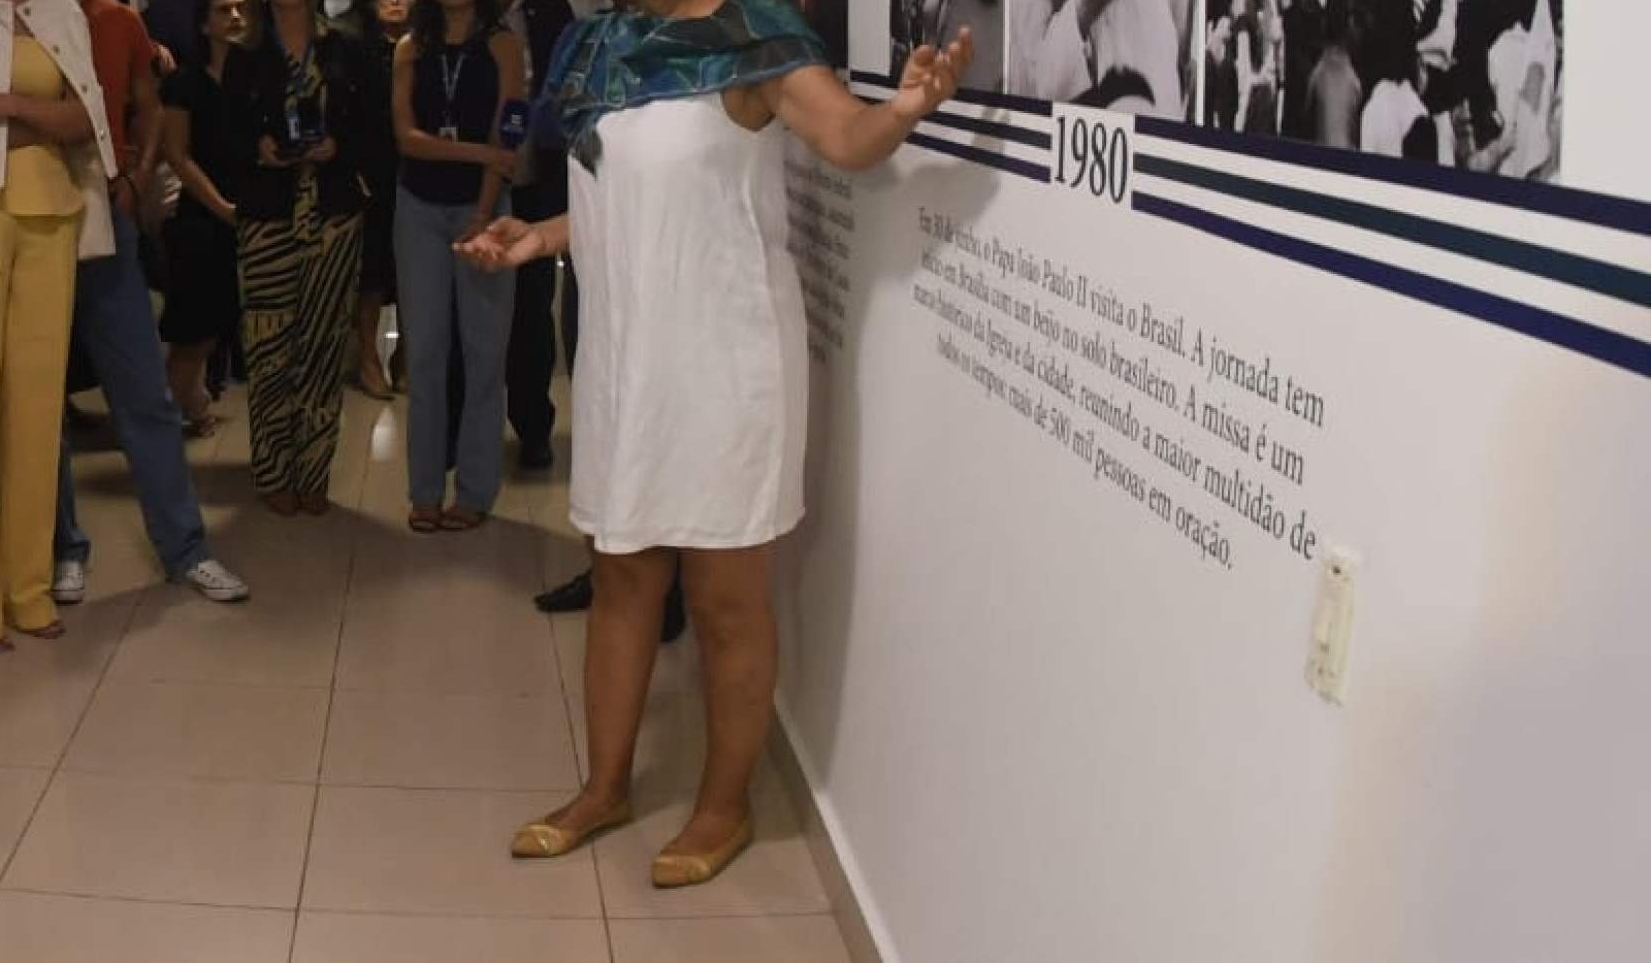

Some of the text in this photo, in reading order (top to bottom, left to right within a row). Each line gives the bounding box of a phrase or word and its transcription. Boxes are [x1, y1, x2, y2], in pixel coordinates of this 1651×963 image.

[1054, 115, 1128, 205] 1980
[1042, 259, 1074, 301] Paulo
[1077, 275, 1087, 308] II
[1090, 286, 1124, 326] visita
[1127, 308, 1137, 331] o
[1140, 303, 1186, 358] Brasil.
[1190, 326, 1204, 367] A
[1207, 335, 1279, 404] jornada
[1285, 376, 1324, 427] tem
[1062, 327, 1078, 352] no
[1081, 330, 1107, 369] solo
[1110, 340, 1179, 412] brasileiro.
[1183, 384, 1196, 422] A
[1202, 401, 1249, 454] missa
[1255, 422, 1268, 462] é
[1271, 439, 1304, 486] um
[1034, 393, 1048, 430] de
[1049, 407, 1071, 446] 500
[1073, 430, 1094, 464] mil
[1095, 446, 1146, 503] pessoas
[1148, 486, 1171, 523] em
[1176, 505, 1233, 571] oração.
[1080, 384, 1139, 442] reunindo
[1142, 425, 1150, 450] a
[1154, 433, 1202, 483] maior
[1204, 468, 1285, 539] multidão
[1289, 508, 1316, 561] de
